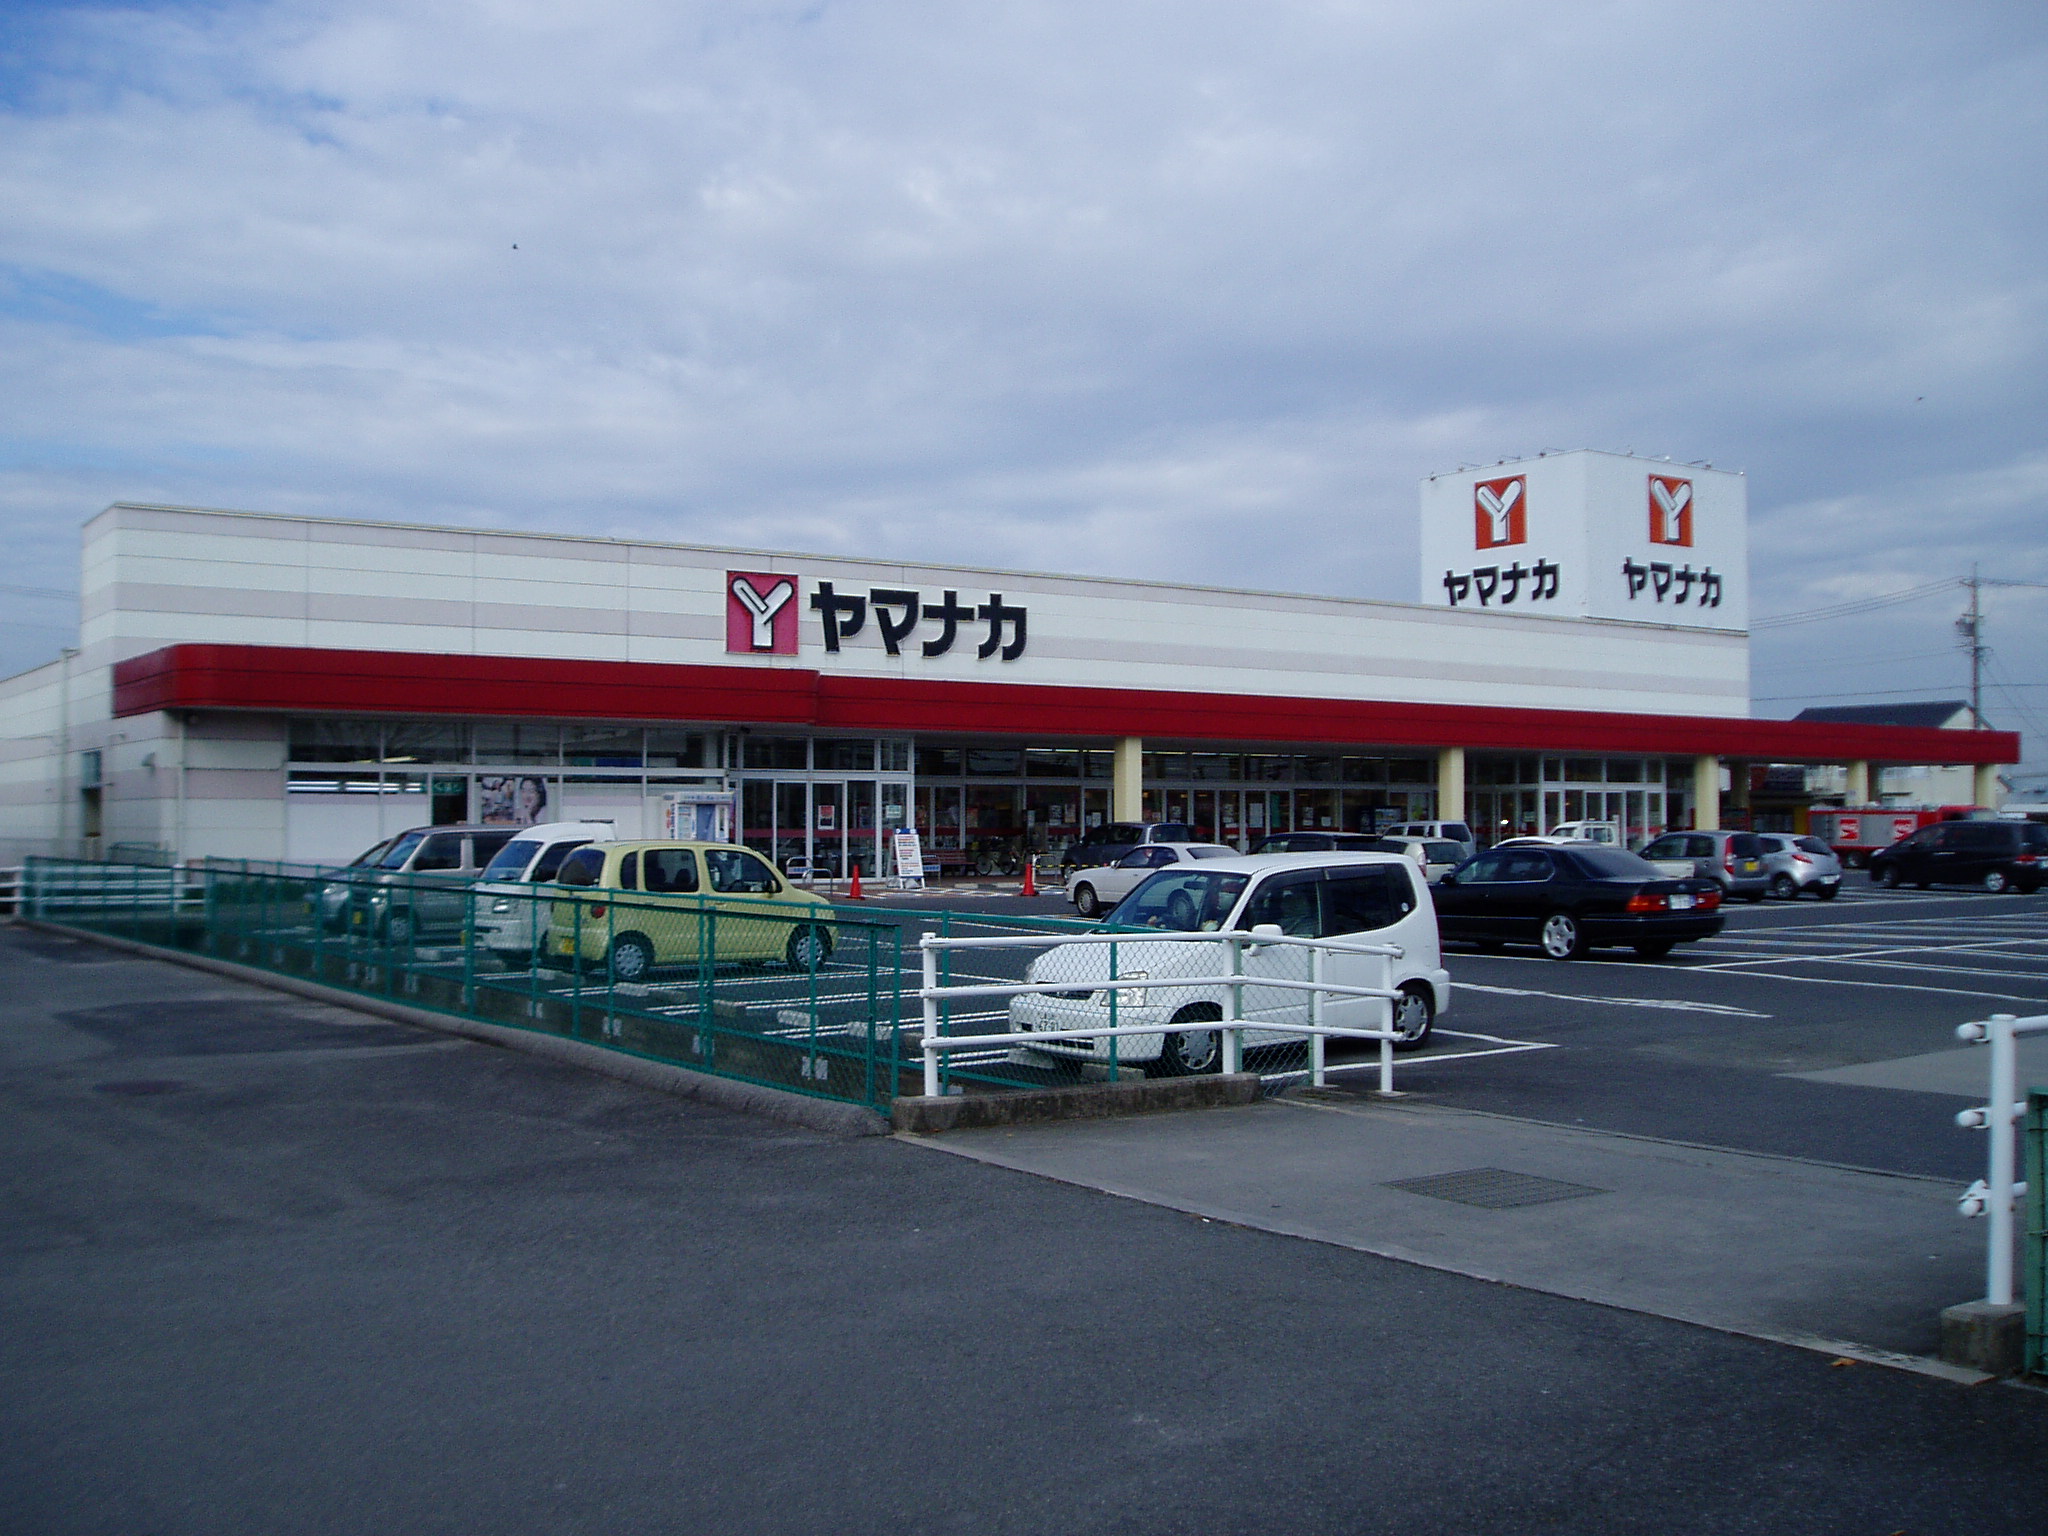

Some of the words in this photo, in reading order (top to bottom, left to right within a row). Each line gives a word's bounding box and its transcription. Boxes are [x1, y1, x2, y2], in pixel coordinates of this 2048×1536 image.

[1444, 557, 1561, 606] ヤマナカ
[1623, 556, 1722, 607] ヤマナカ
[810, 581, 1028, 661] ヤマナカ
